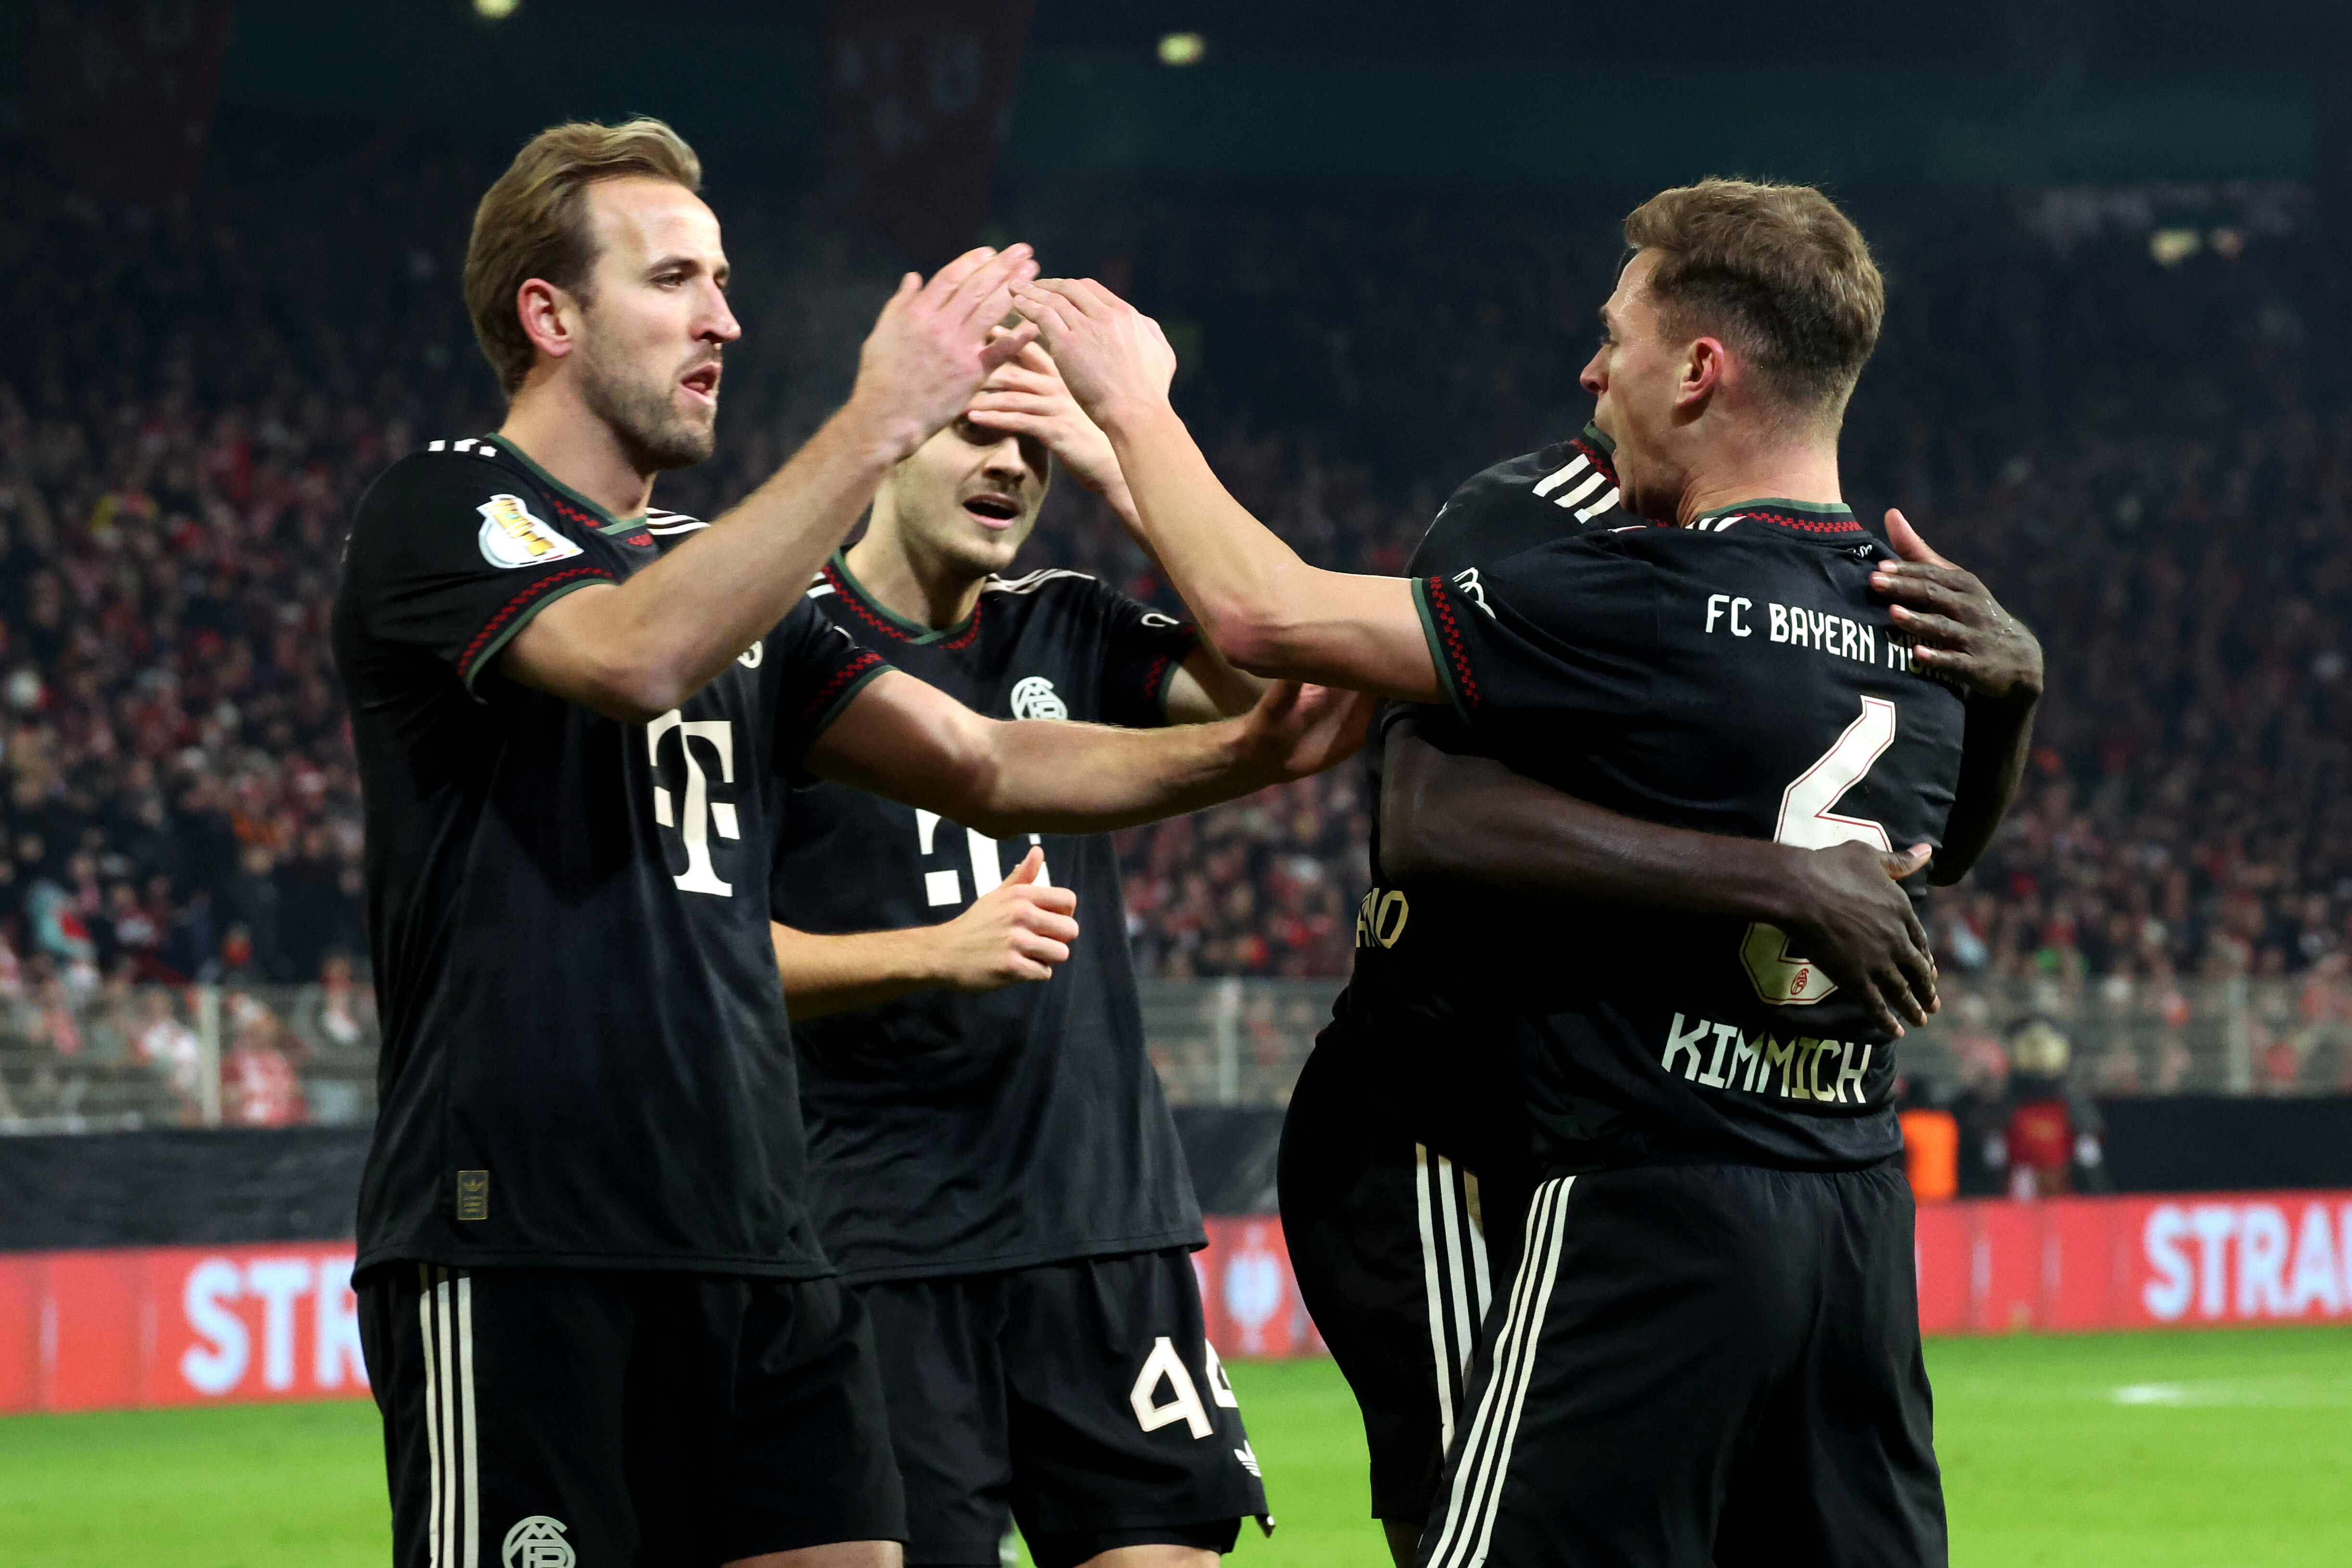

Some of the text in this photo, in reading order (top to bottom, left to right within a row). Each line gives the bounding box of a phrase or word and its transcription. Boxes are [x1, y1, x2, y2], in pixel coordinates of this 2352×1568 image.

[1705, 594, 1753, 637] FC
[1768, 602, 1876, 664] BAYERN
[1661, 1012, 1872, 1104] KIMMICH
[2142, 1203, 2352, 1321] STRA
[181, 1255, 373, 1395] STR
